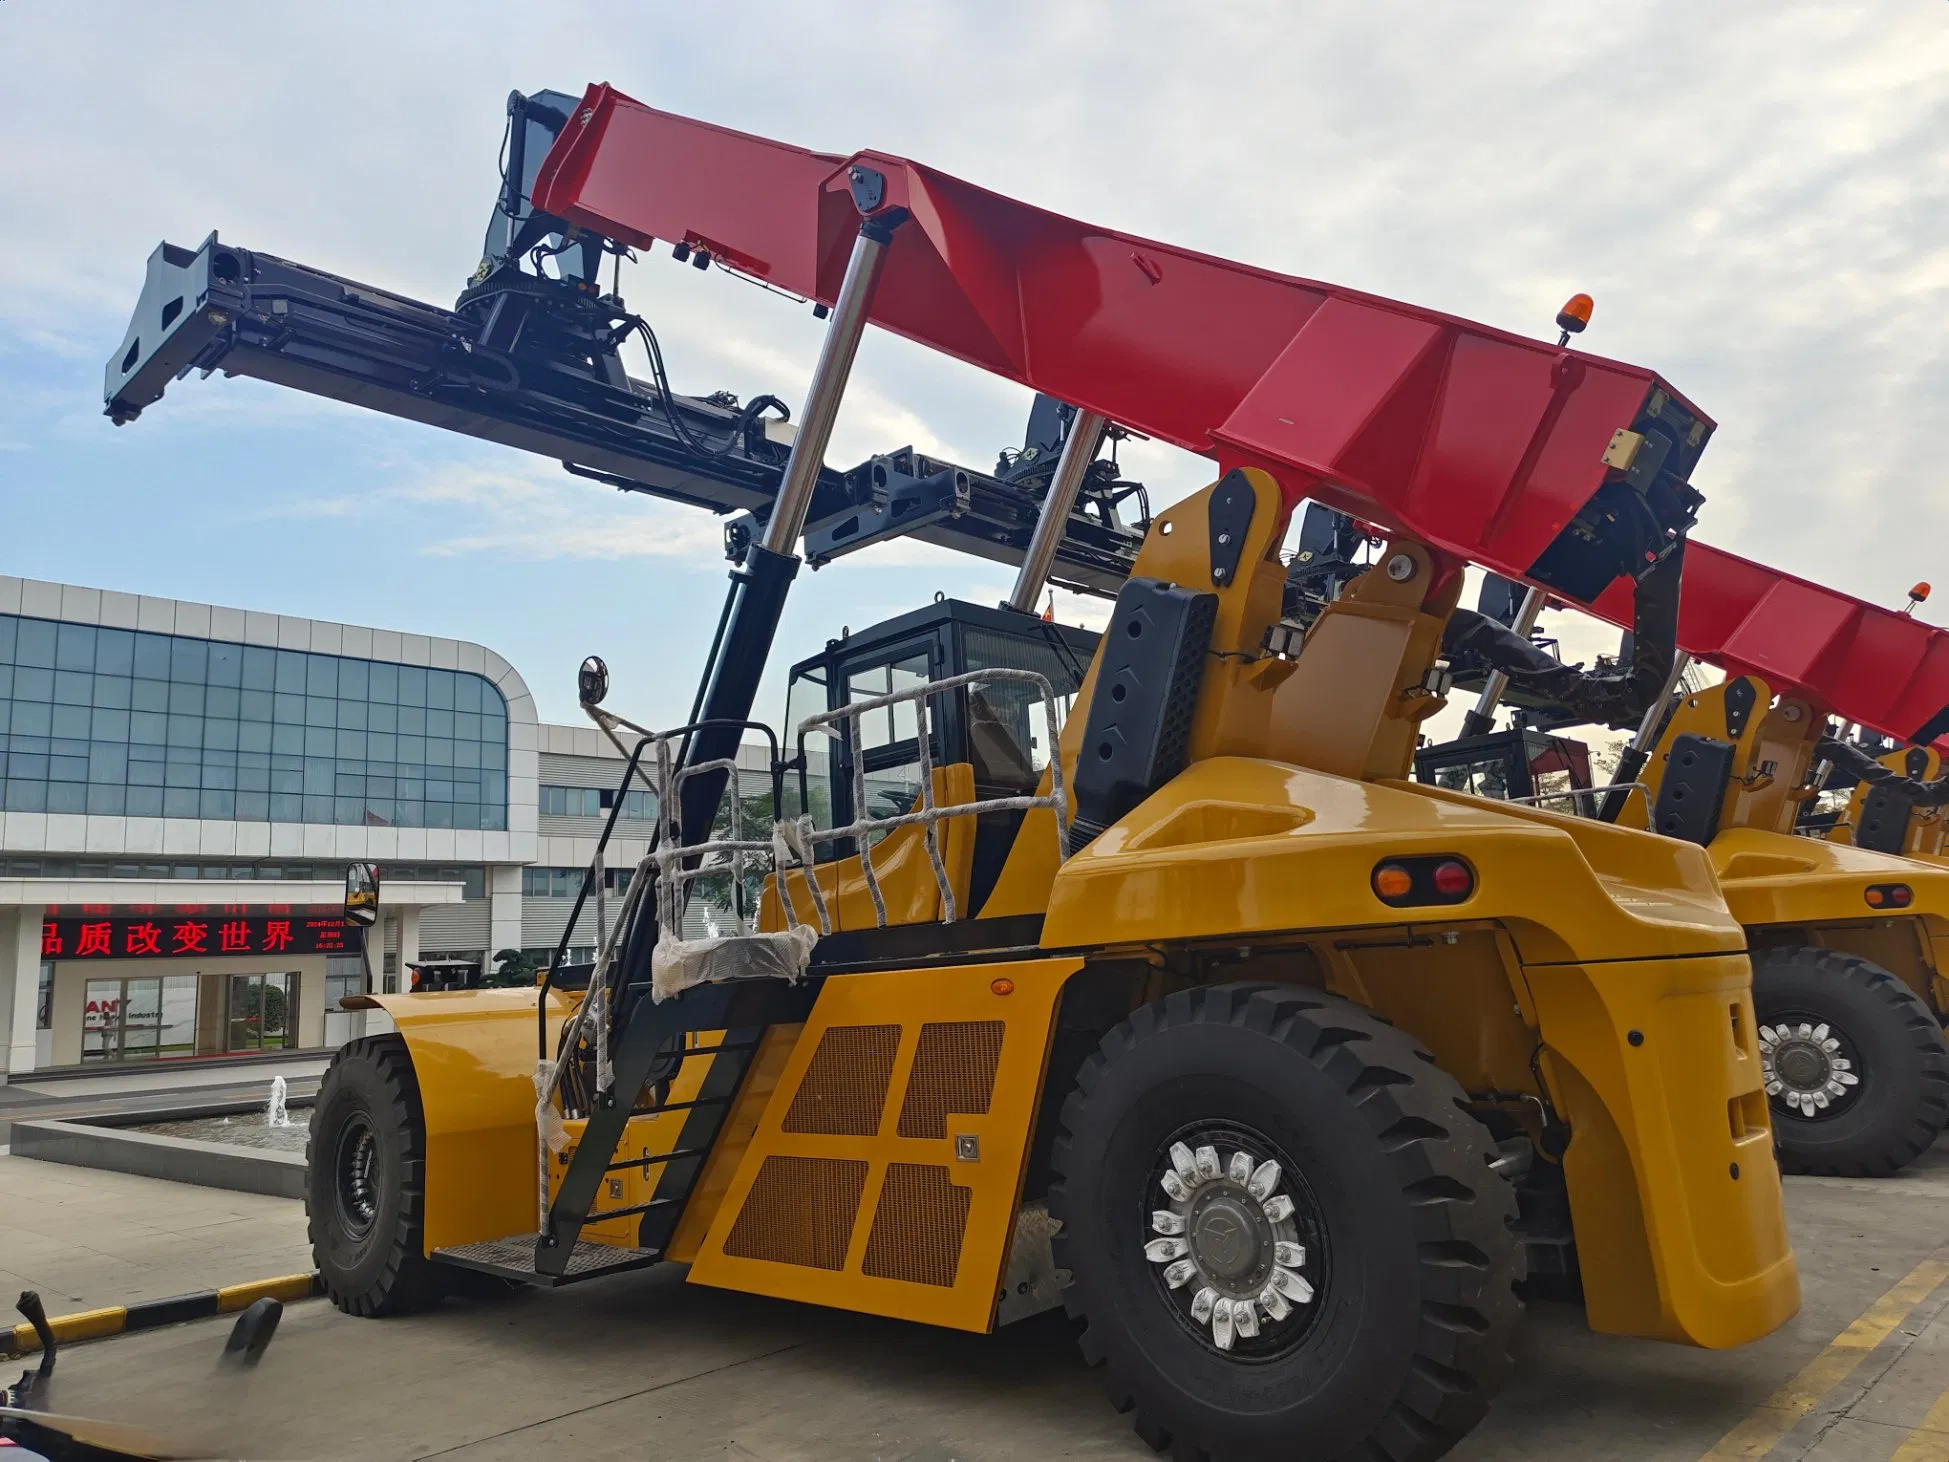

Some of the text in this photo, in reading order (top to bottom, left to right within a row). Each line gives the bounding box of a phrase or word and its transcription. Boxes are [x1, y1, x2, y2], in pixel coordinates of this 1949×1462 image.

[41, 920, 294, 956] 品质改变世界
